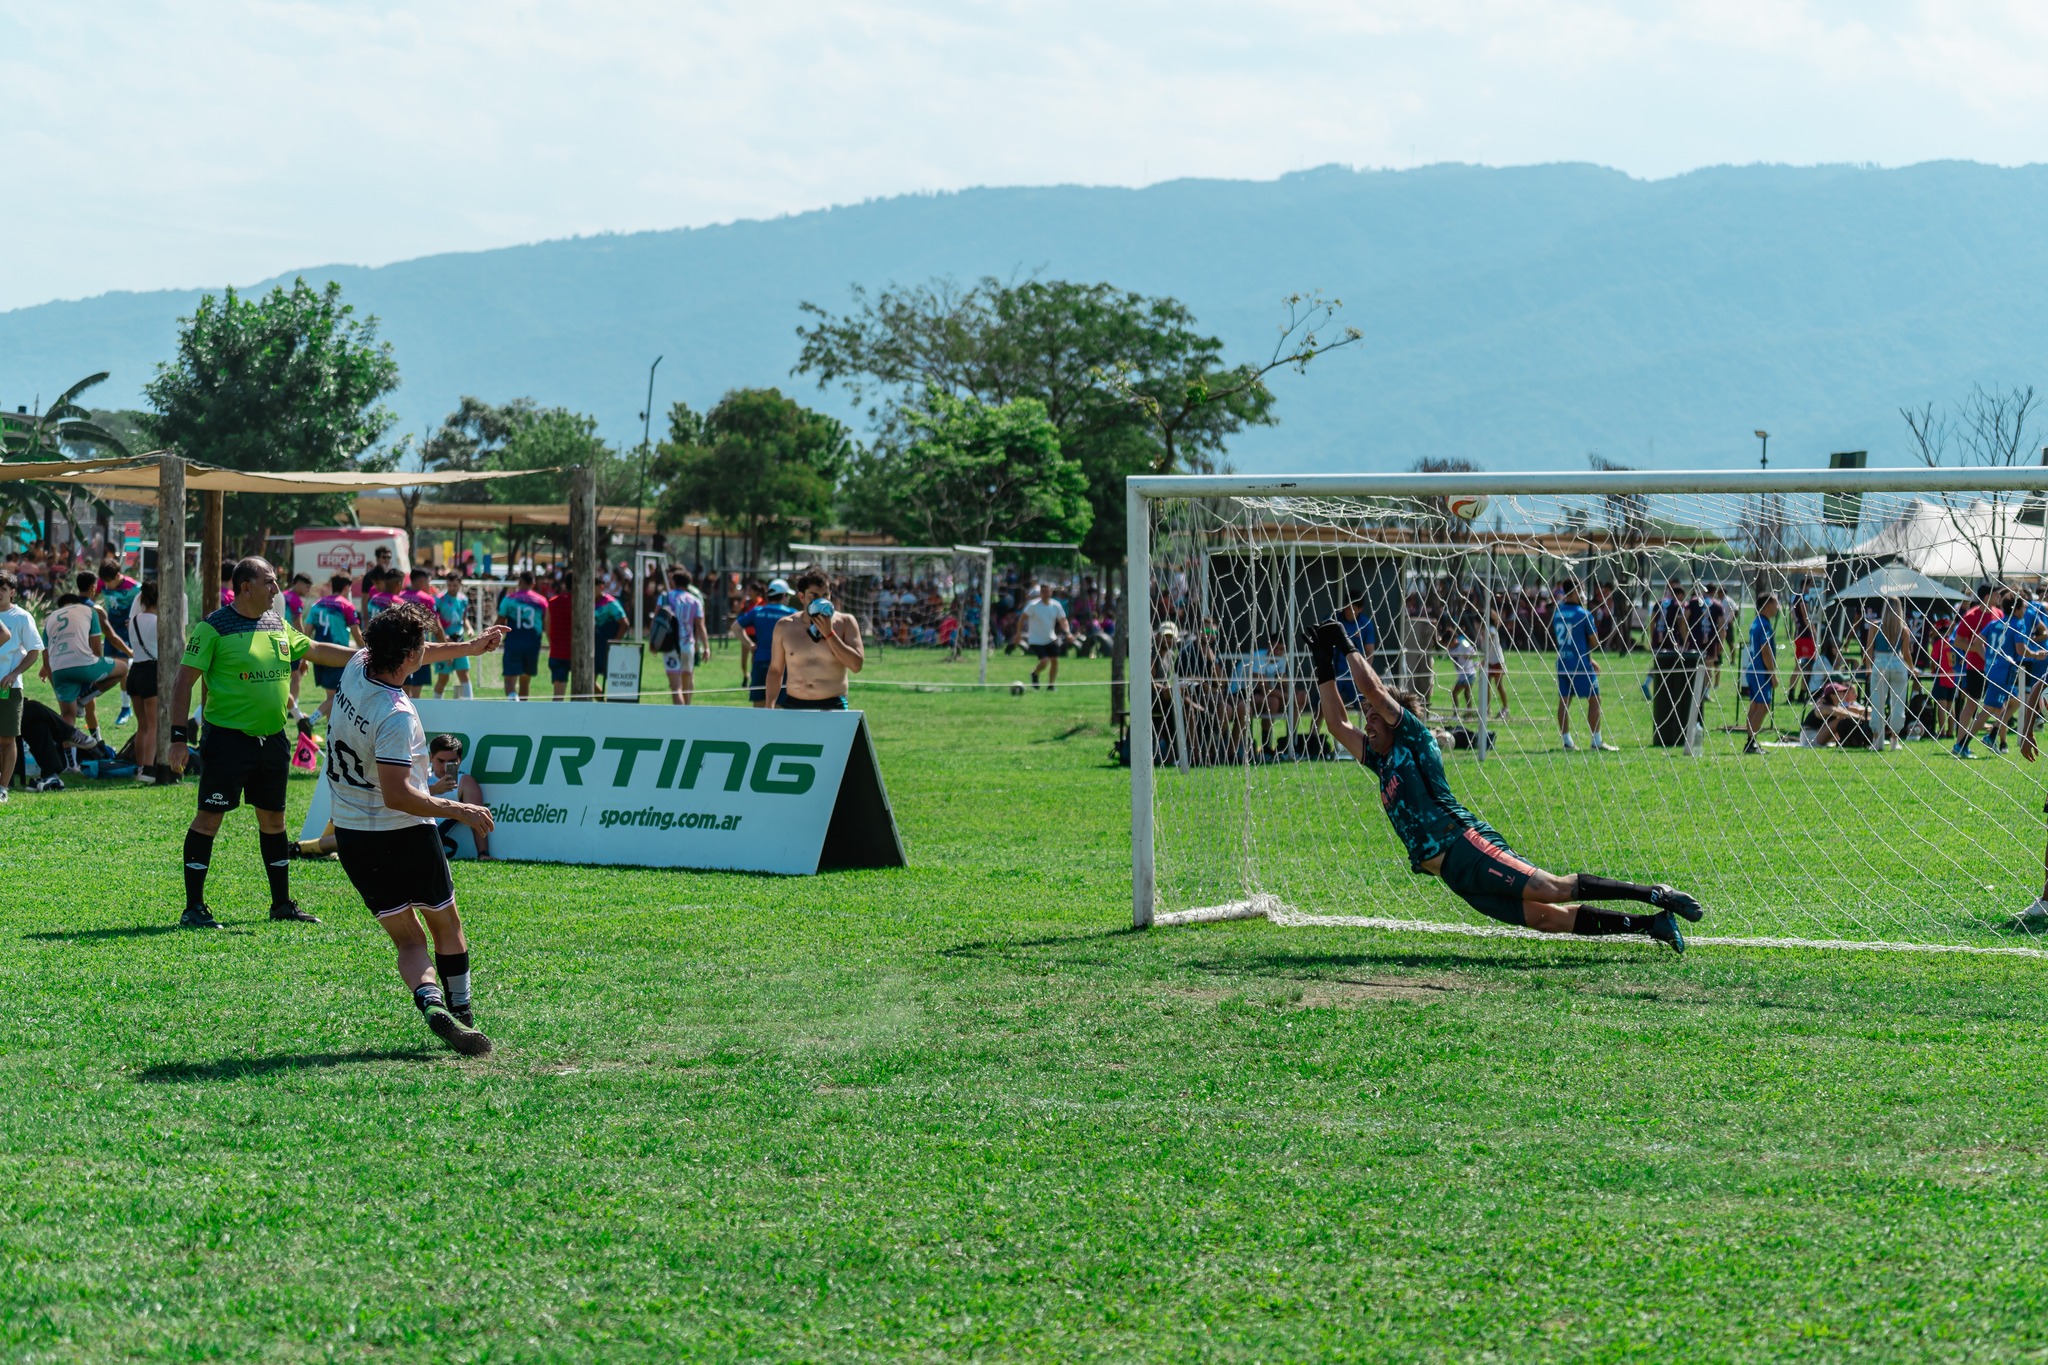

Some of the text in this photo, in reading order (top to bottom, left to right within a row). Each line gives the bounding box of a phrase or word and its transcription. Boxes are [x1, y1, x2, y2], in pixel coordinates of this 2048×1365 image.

[56, 611, 69, 631] 5
[318, 610, 330, 636] 4
[516, 606, 535, 629] 13
[1555, 623, 1573, 645] 21
[354, 715, 370, 735] FC
[599, 806, 742, 831] sporting.com.ar
